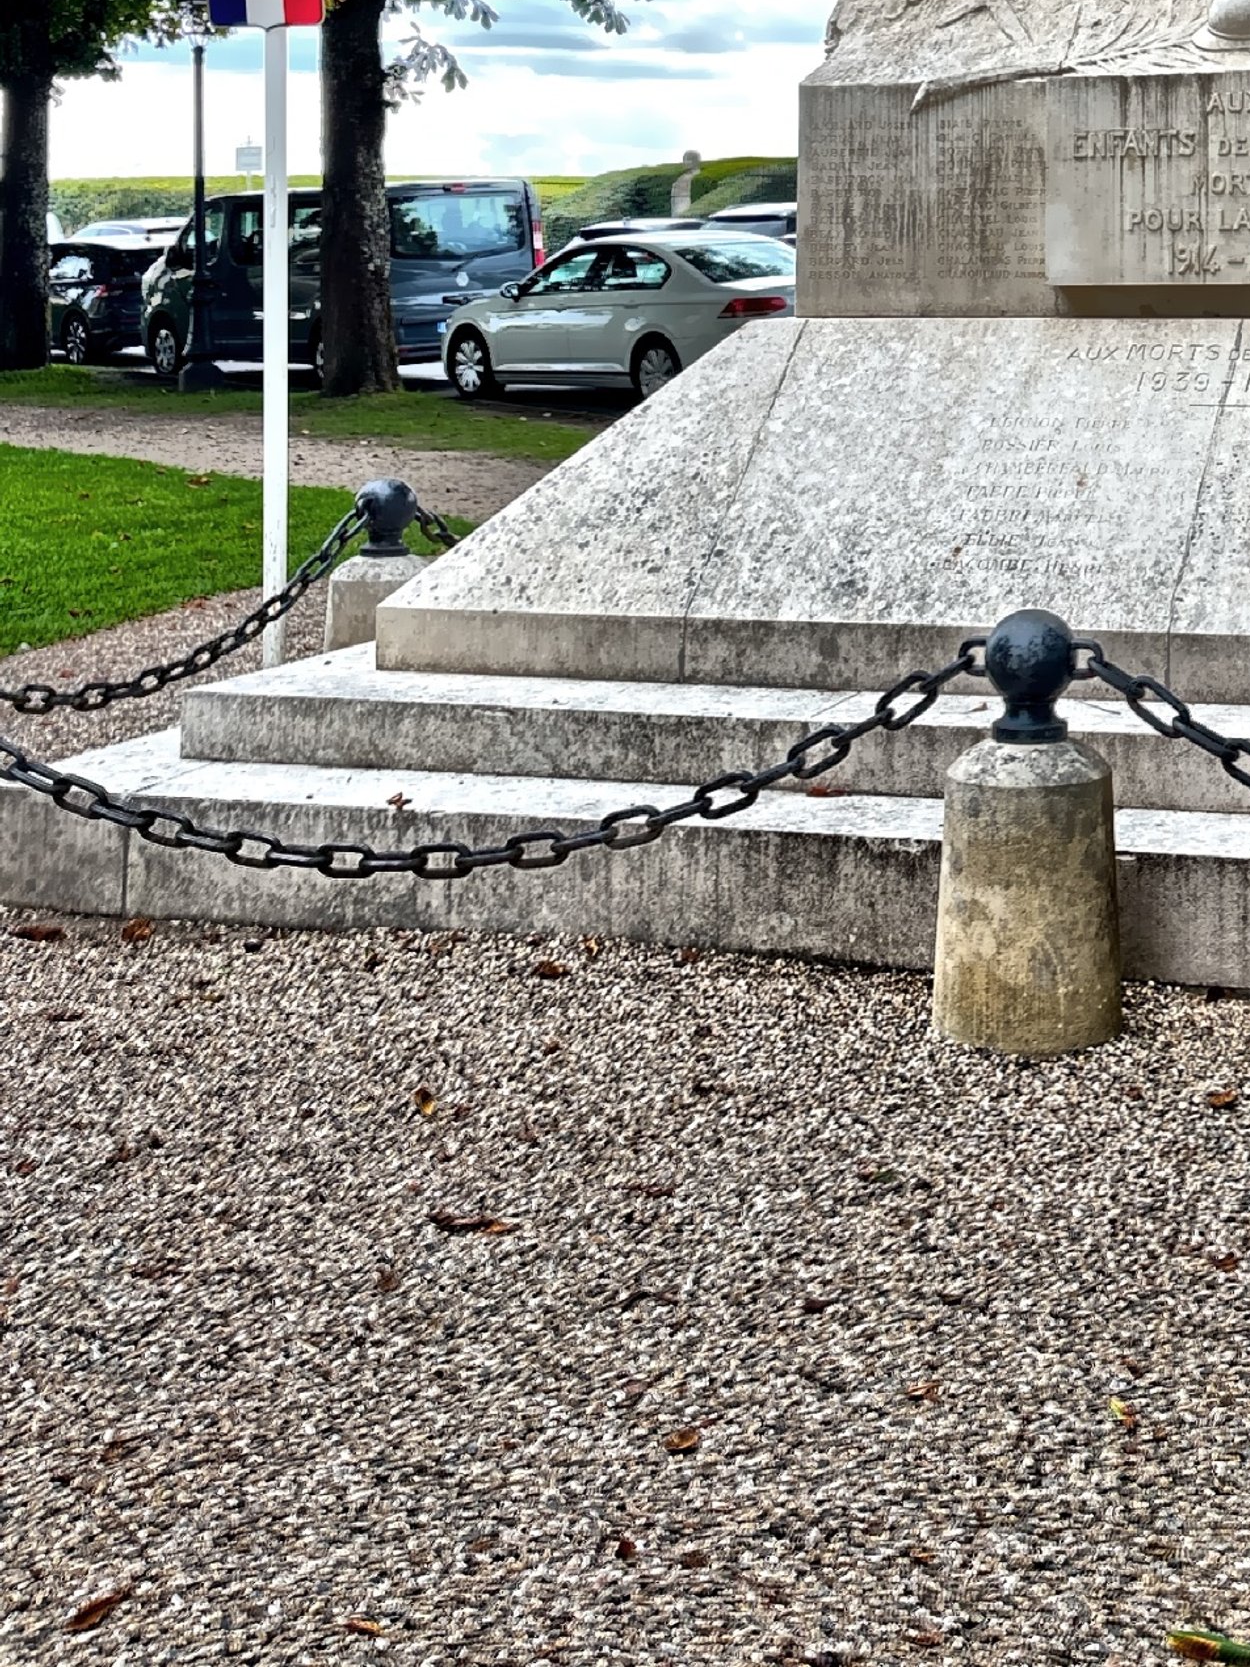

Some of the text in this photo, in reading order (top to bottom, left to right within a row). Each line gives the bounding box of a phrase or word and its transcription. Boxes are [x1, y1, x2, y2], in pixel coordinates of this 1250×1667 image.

[1073, 130, 1196, 158] ENFANTS
[1217, 136, 1249, 156] DE
[1128, 209, 1204, 233] POUR
[1166, 243, 1221, 275] 1914
[1066, 346, 1120, 361] AUX
[1126, 344, 1220, 361] MORTS
[1136, 372, 1211, 393] 1939
